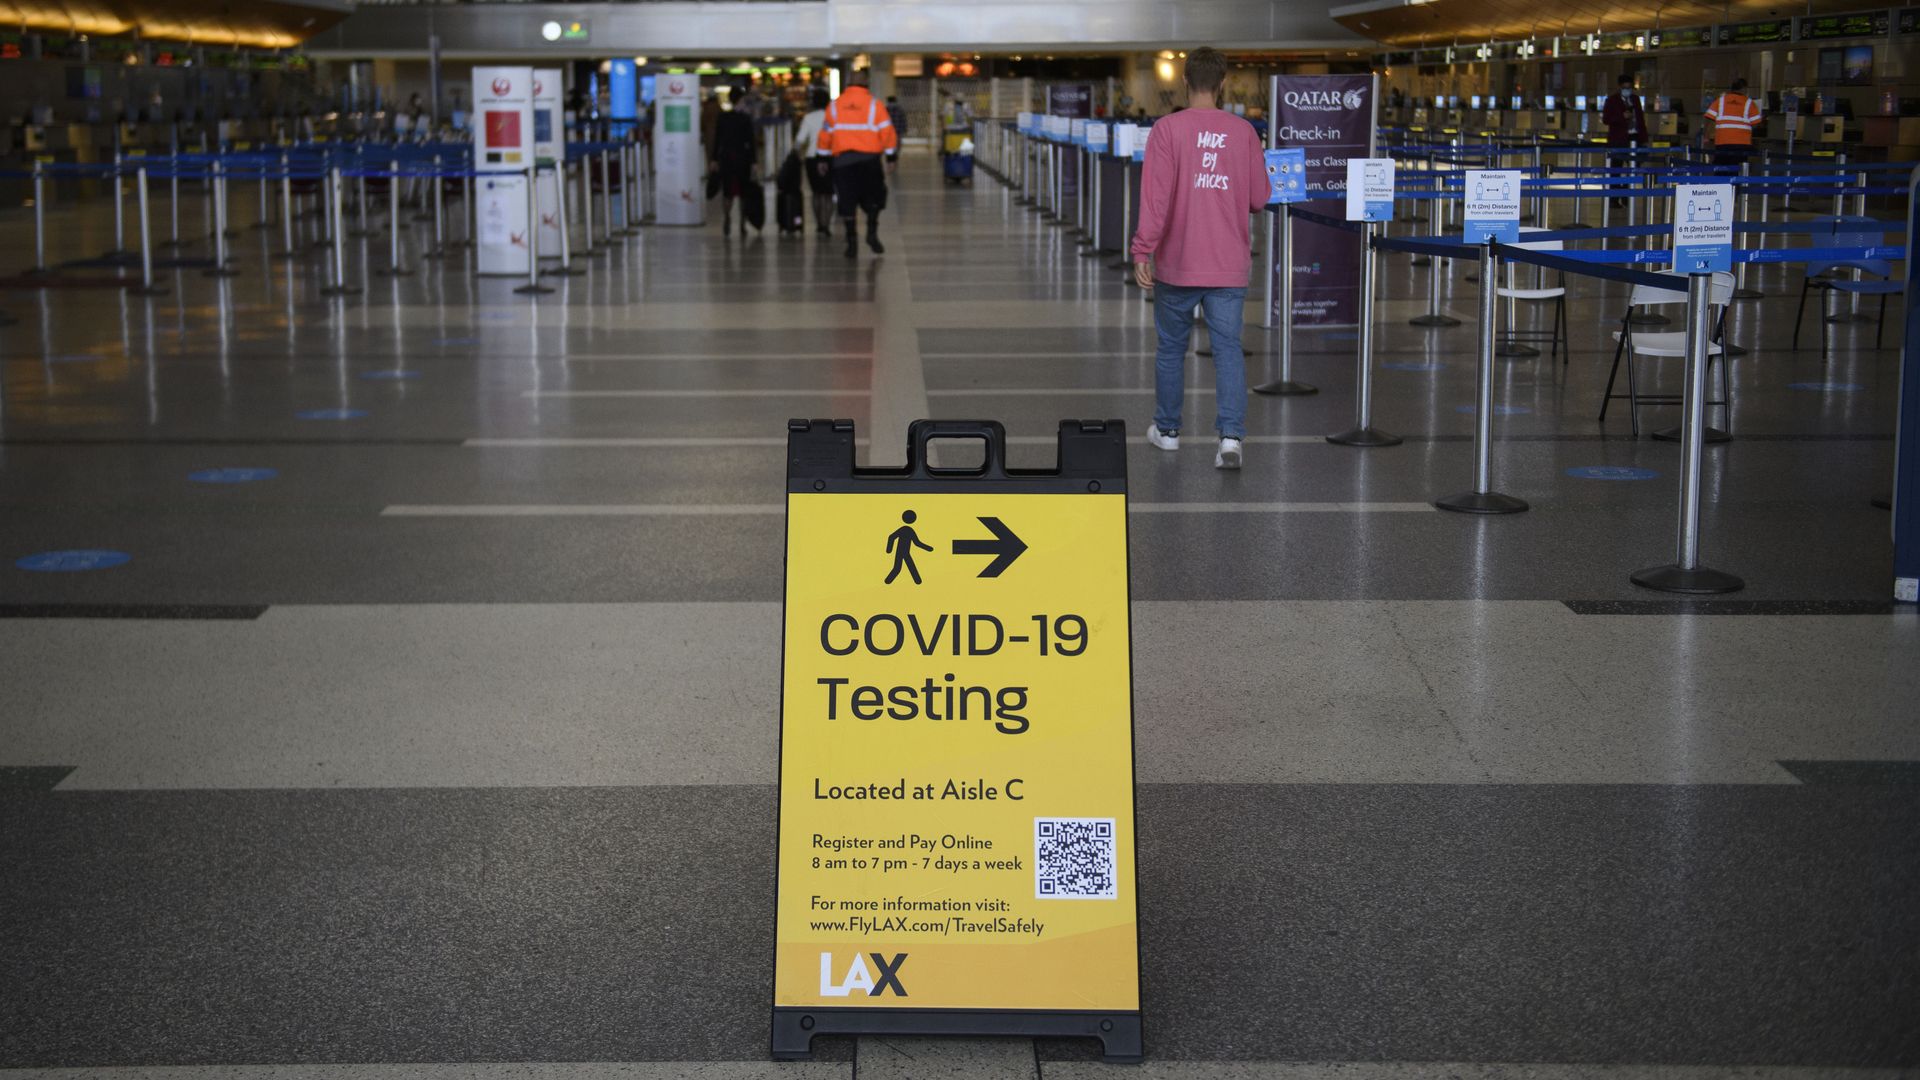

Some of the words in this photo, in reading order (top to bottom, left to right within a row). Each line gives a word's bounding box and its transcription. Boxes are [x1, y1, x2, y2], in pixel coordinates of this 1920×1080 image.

[1284, 91, 1342, 108] QATAR
[1279, 126, 1341, 140] Check-in
[1202, 151, 1218, 172] BY
[1323, 156, 1347, 167] Class
[1696, 260, 1709, 269] LAX
[820, 614, 1089, 657] COVID-19
[817, 673, 1030, 735] Testing
[814, 778, 905, 800] Located
[912, 783, 935, 800] at
[940, 778, 998, 800] Aisle
[1005, 778, 1024, 800] C
[812, 834, 874, 852] Register
[878, 834, 905, 849] and
[910, 834, 937, 853] Pay
[941, 834, 993, 849] Online
[811, 857, 821, 869] 8
[825, 859, 847, 869] am
[852, 858, 867, 869] to
[871, 857, 880, 869] 7
[883, 859, 908, 873] pm
[922, 857, 931, 869] 7
[934, 855, 968, 874] days
[972, 860, 980, 870] a
[984, 855, 1023, 870] week
[811, 895, 836, 910] For
[840, 900, 879, 911] more
[883, 896, 971, 911] information
[975, 898, 1011, 912] visit:
[820, 951, 909, 997] LAX
